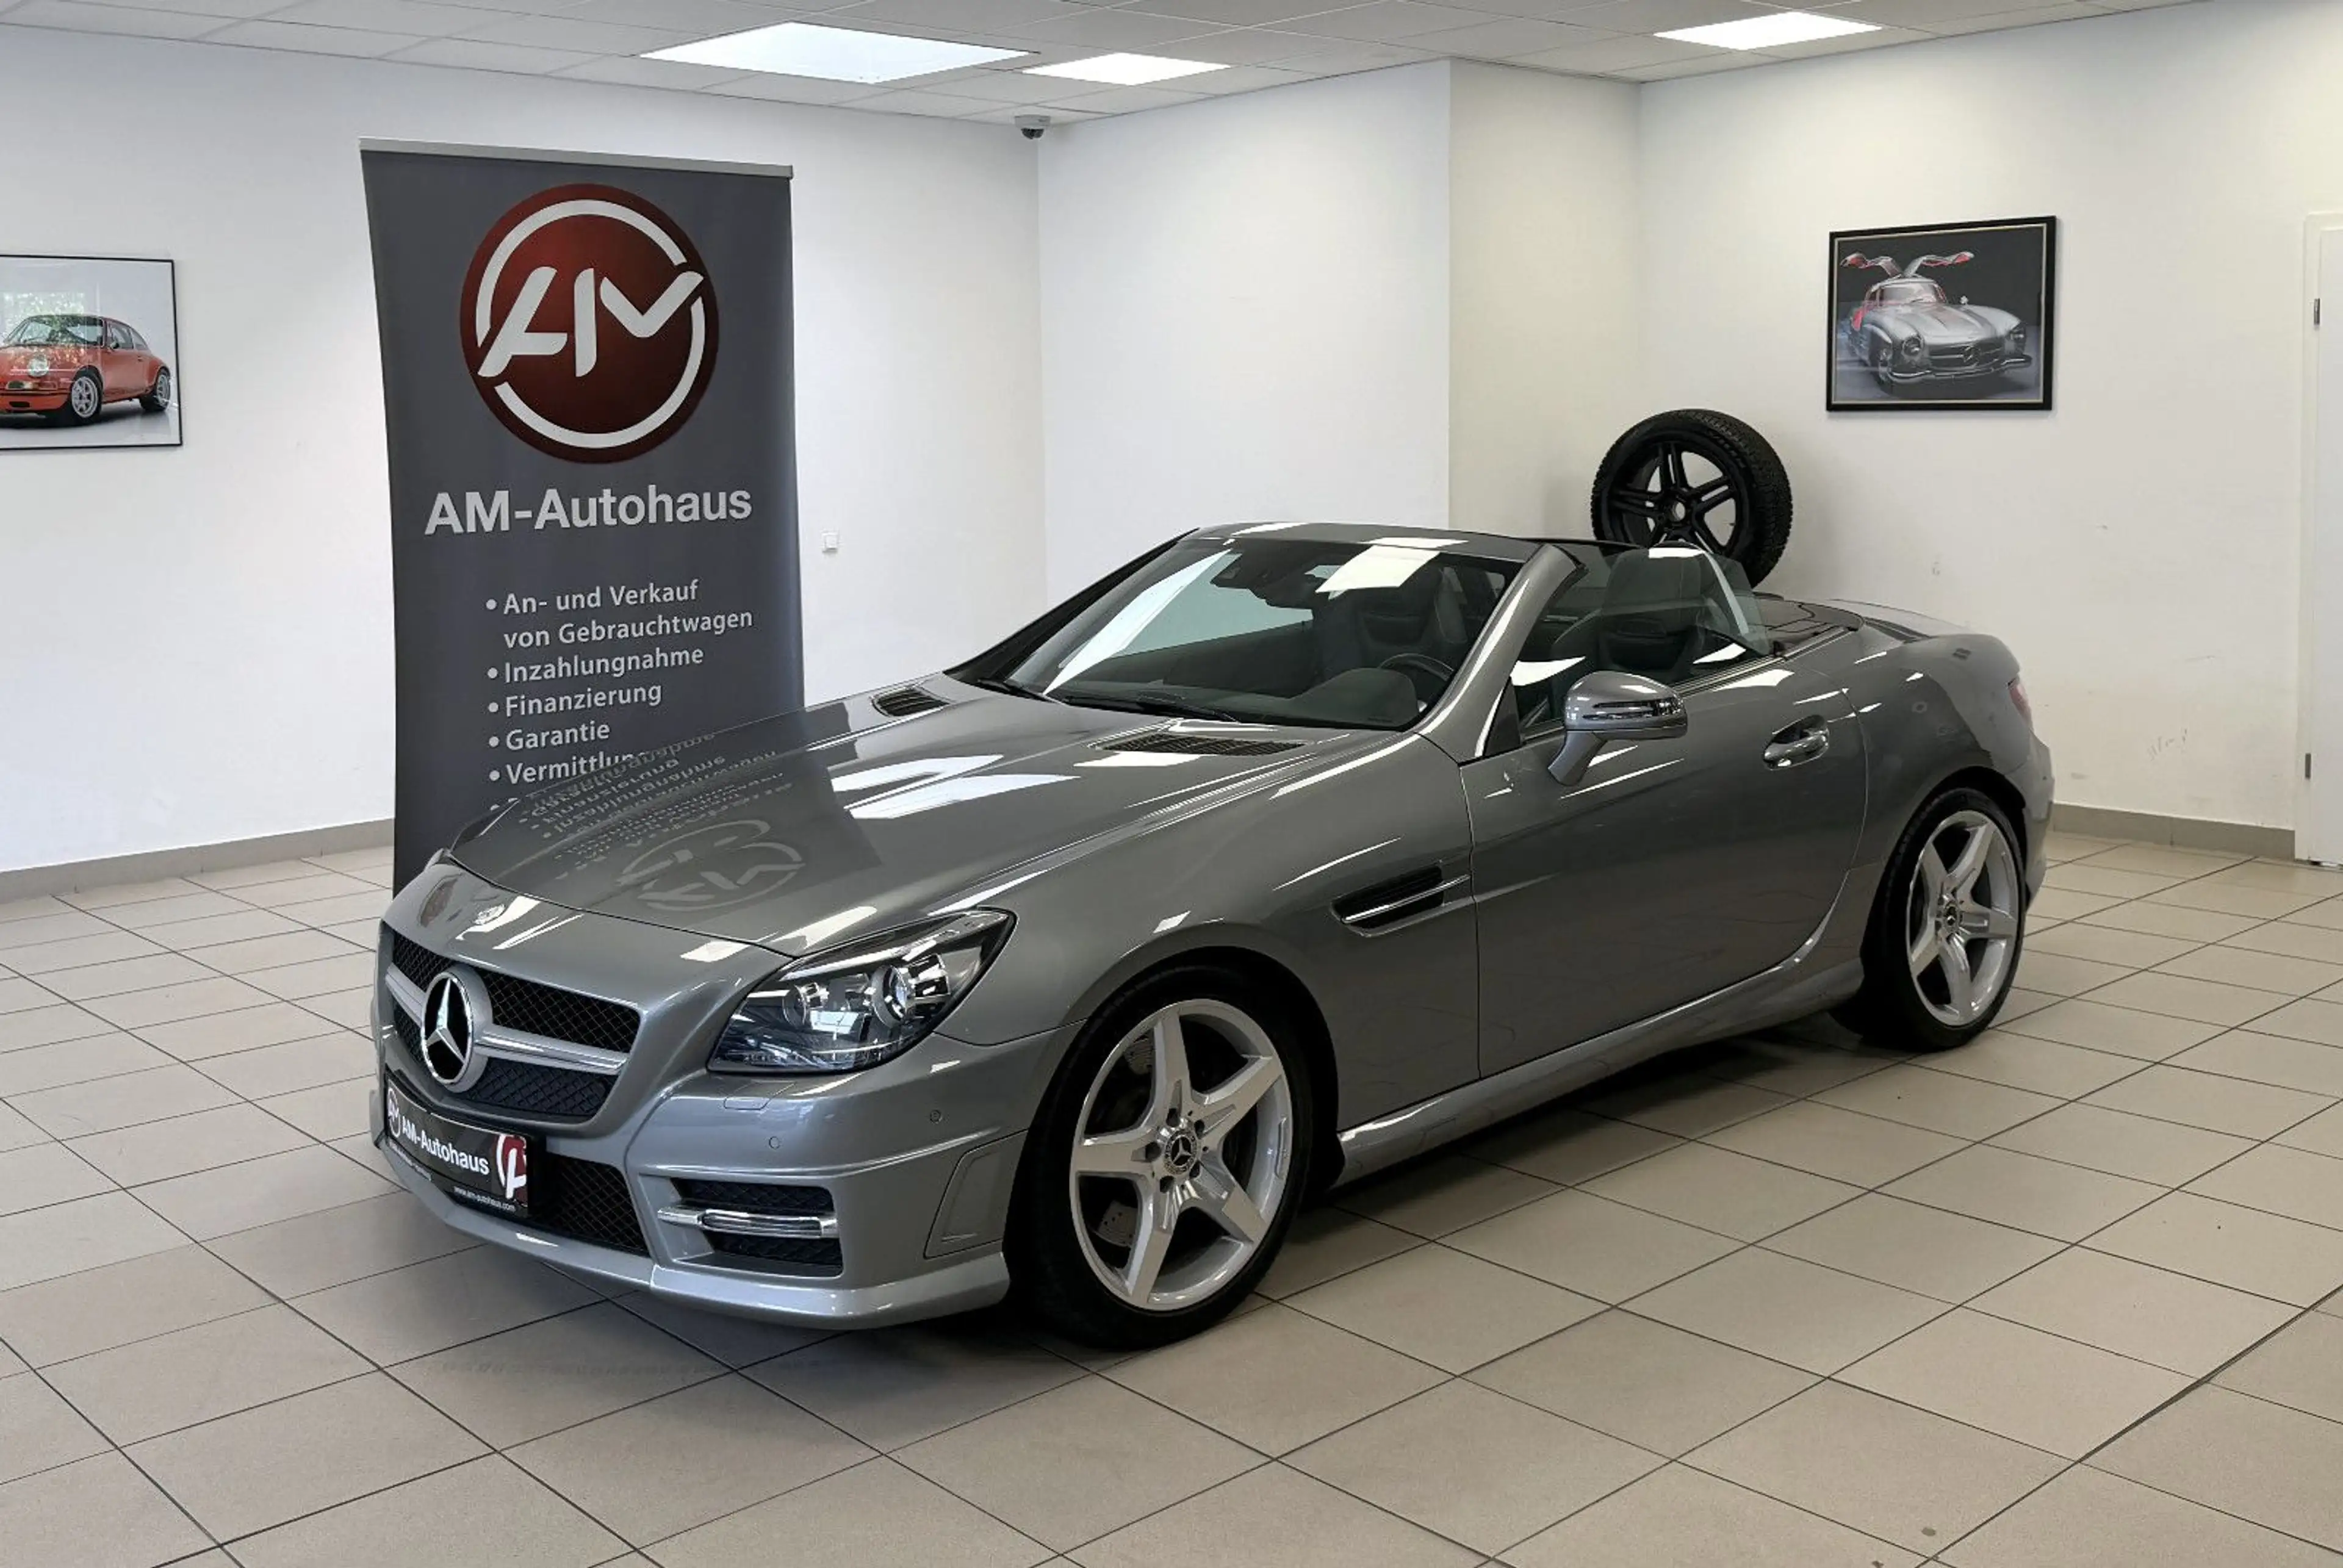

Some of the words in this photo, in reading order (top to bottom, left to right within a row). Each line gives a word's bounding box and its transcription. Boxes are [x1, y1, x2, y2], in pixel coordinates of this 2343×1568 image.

[425, 485, 752, 535] AM-Autohaus
[504, 594, 548, 614] An-
[556, 586, 601, 611] und
[610, 579, 699, 606] Verkauf
[504, 624, 550, 649] von
[559, 613, 752, 645] Gebrauchtwagen
[505, 647, 704, 683] Inzahlungnahme
[506, 686, 661, 717] Finanzierung
[506, 720, 610, 750] Garantie
[403, 1115, 490, 1176] AM-Autohaus
